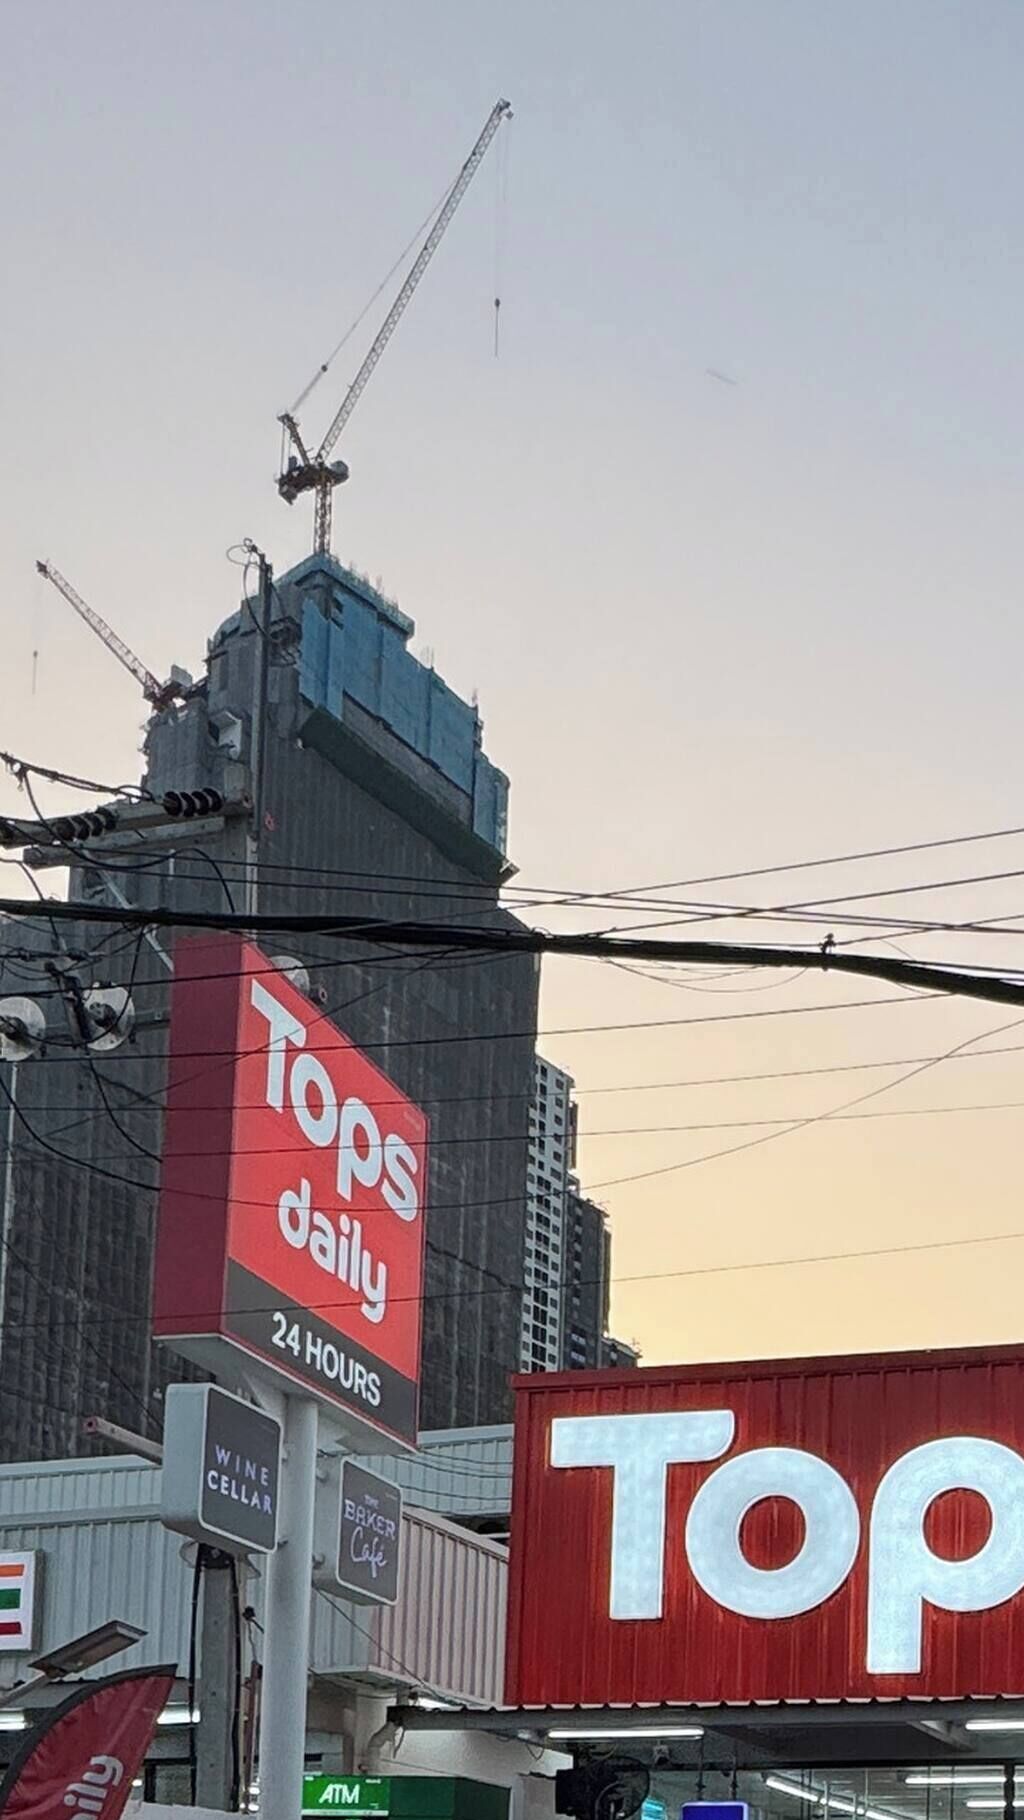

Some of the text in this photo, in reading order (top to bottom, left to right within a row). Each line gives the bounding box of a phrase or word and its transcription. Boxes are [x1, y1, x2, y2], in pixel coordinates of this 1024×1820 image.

[251, 978, 418, 1222] Tops
[278, 1177, 387, 1323] daily
[272, 1311, 380, 1407] 24 HOURS
[215, 1444, 270, 1487] WINE
[207, 1469, 273, 1516] CELLAR
[344, 1499, 396, 1541] BAKER
[319, 1784, 361, 1804] ATM
